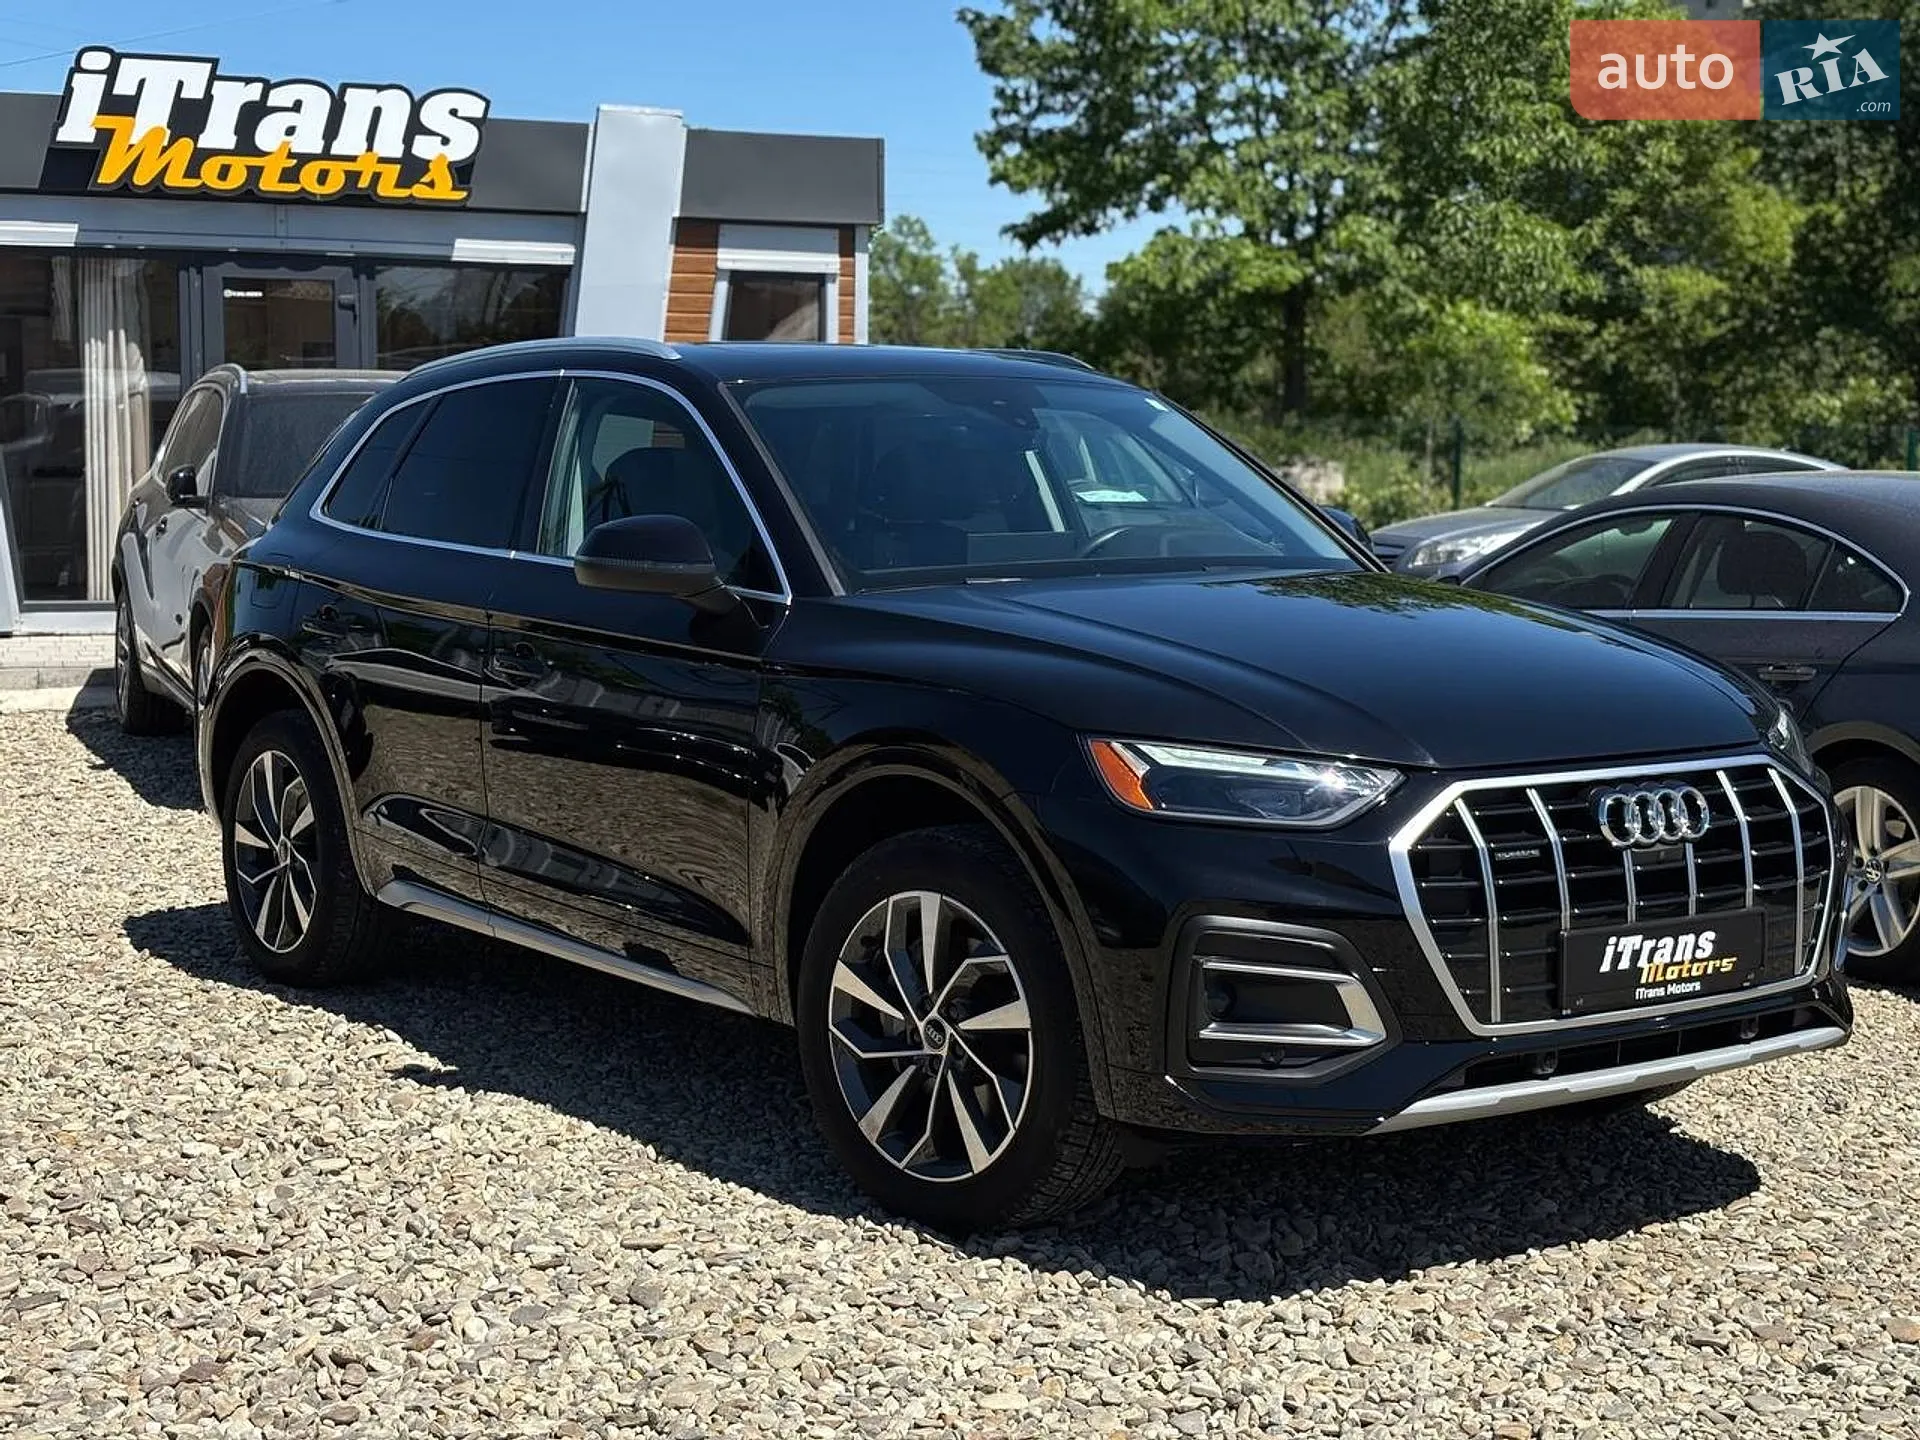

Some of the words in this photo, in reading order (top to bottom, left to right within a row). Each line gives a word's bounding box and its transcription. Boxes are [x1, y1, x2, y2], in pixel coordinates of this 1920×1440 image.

[56, 50, 487, 161] iTrans
[92, 115, 469, 201] Motors
[1599, 930, 1717, 973] iTrans
[1639, 957, 1738, 984] Motors
[1667, 981, 1701, 996] Motors
